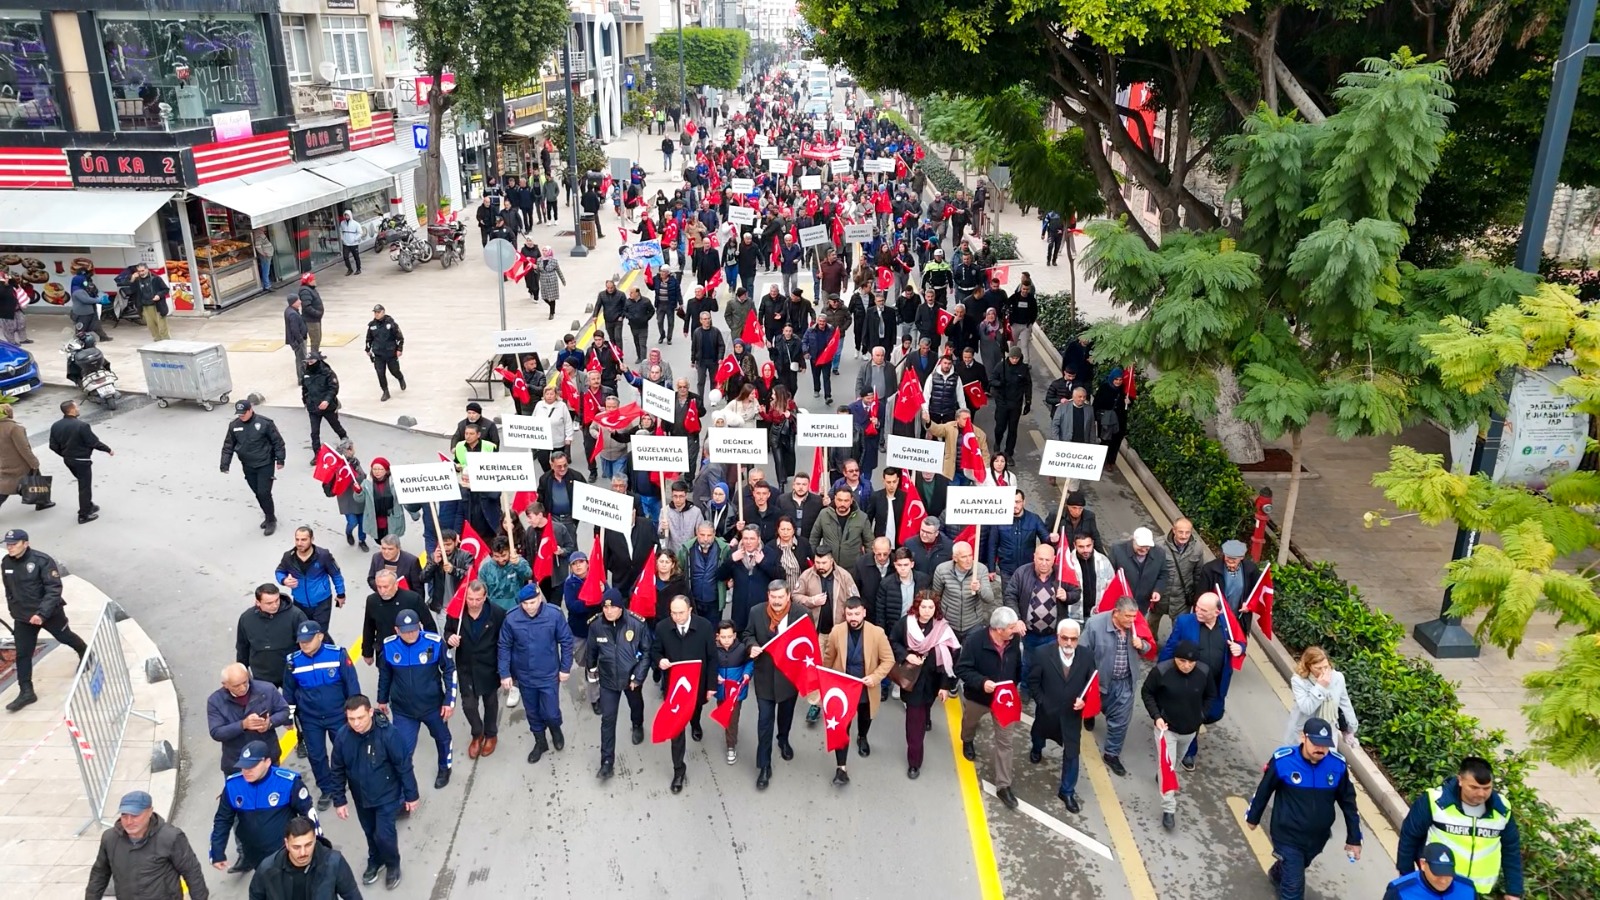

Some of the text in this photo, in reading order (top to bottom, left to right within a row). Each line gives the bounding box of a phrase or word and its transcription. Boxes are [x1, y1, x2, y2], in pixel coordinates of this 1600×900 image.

[336, 128, 343, 141] 2
[118, 157, 145, 173] KA
[162, 157, 175, 174] 2
[509, 424, 544, 432] KURUDERE
[508, 432, 547, 440] MUHTARLIĞI
[902, 446, 929, 455] ÇANDIR
[1055, 450, 1093, 461] SOĞUCAK
[638, 454, 683, 462] MUHTARLIĞI
[892, 453, 938, 464] MUHTARLIĞI
[479, 462, 523, 471] KERİMLER
[1048, 460, 1096, 470] MUHTARLIĞI
[476, 473, 529, 482] MUHTARLIĞI
[402, 483, 452, 493] MUHTARLIĞI
[586, 496, 619, 511] PORTAKAL
[582, 505, 622, 522] MUHTARLIĞI
